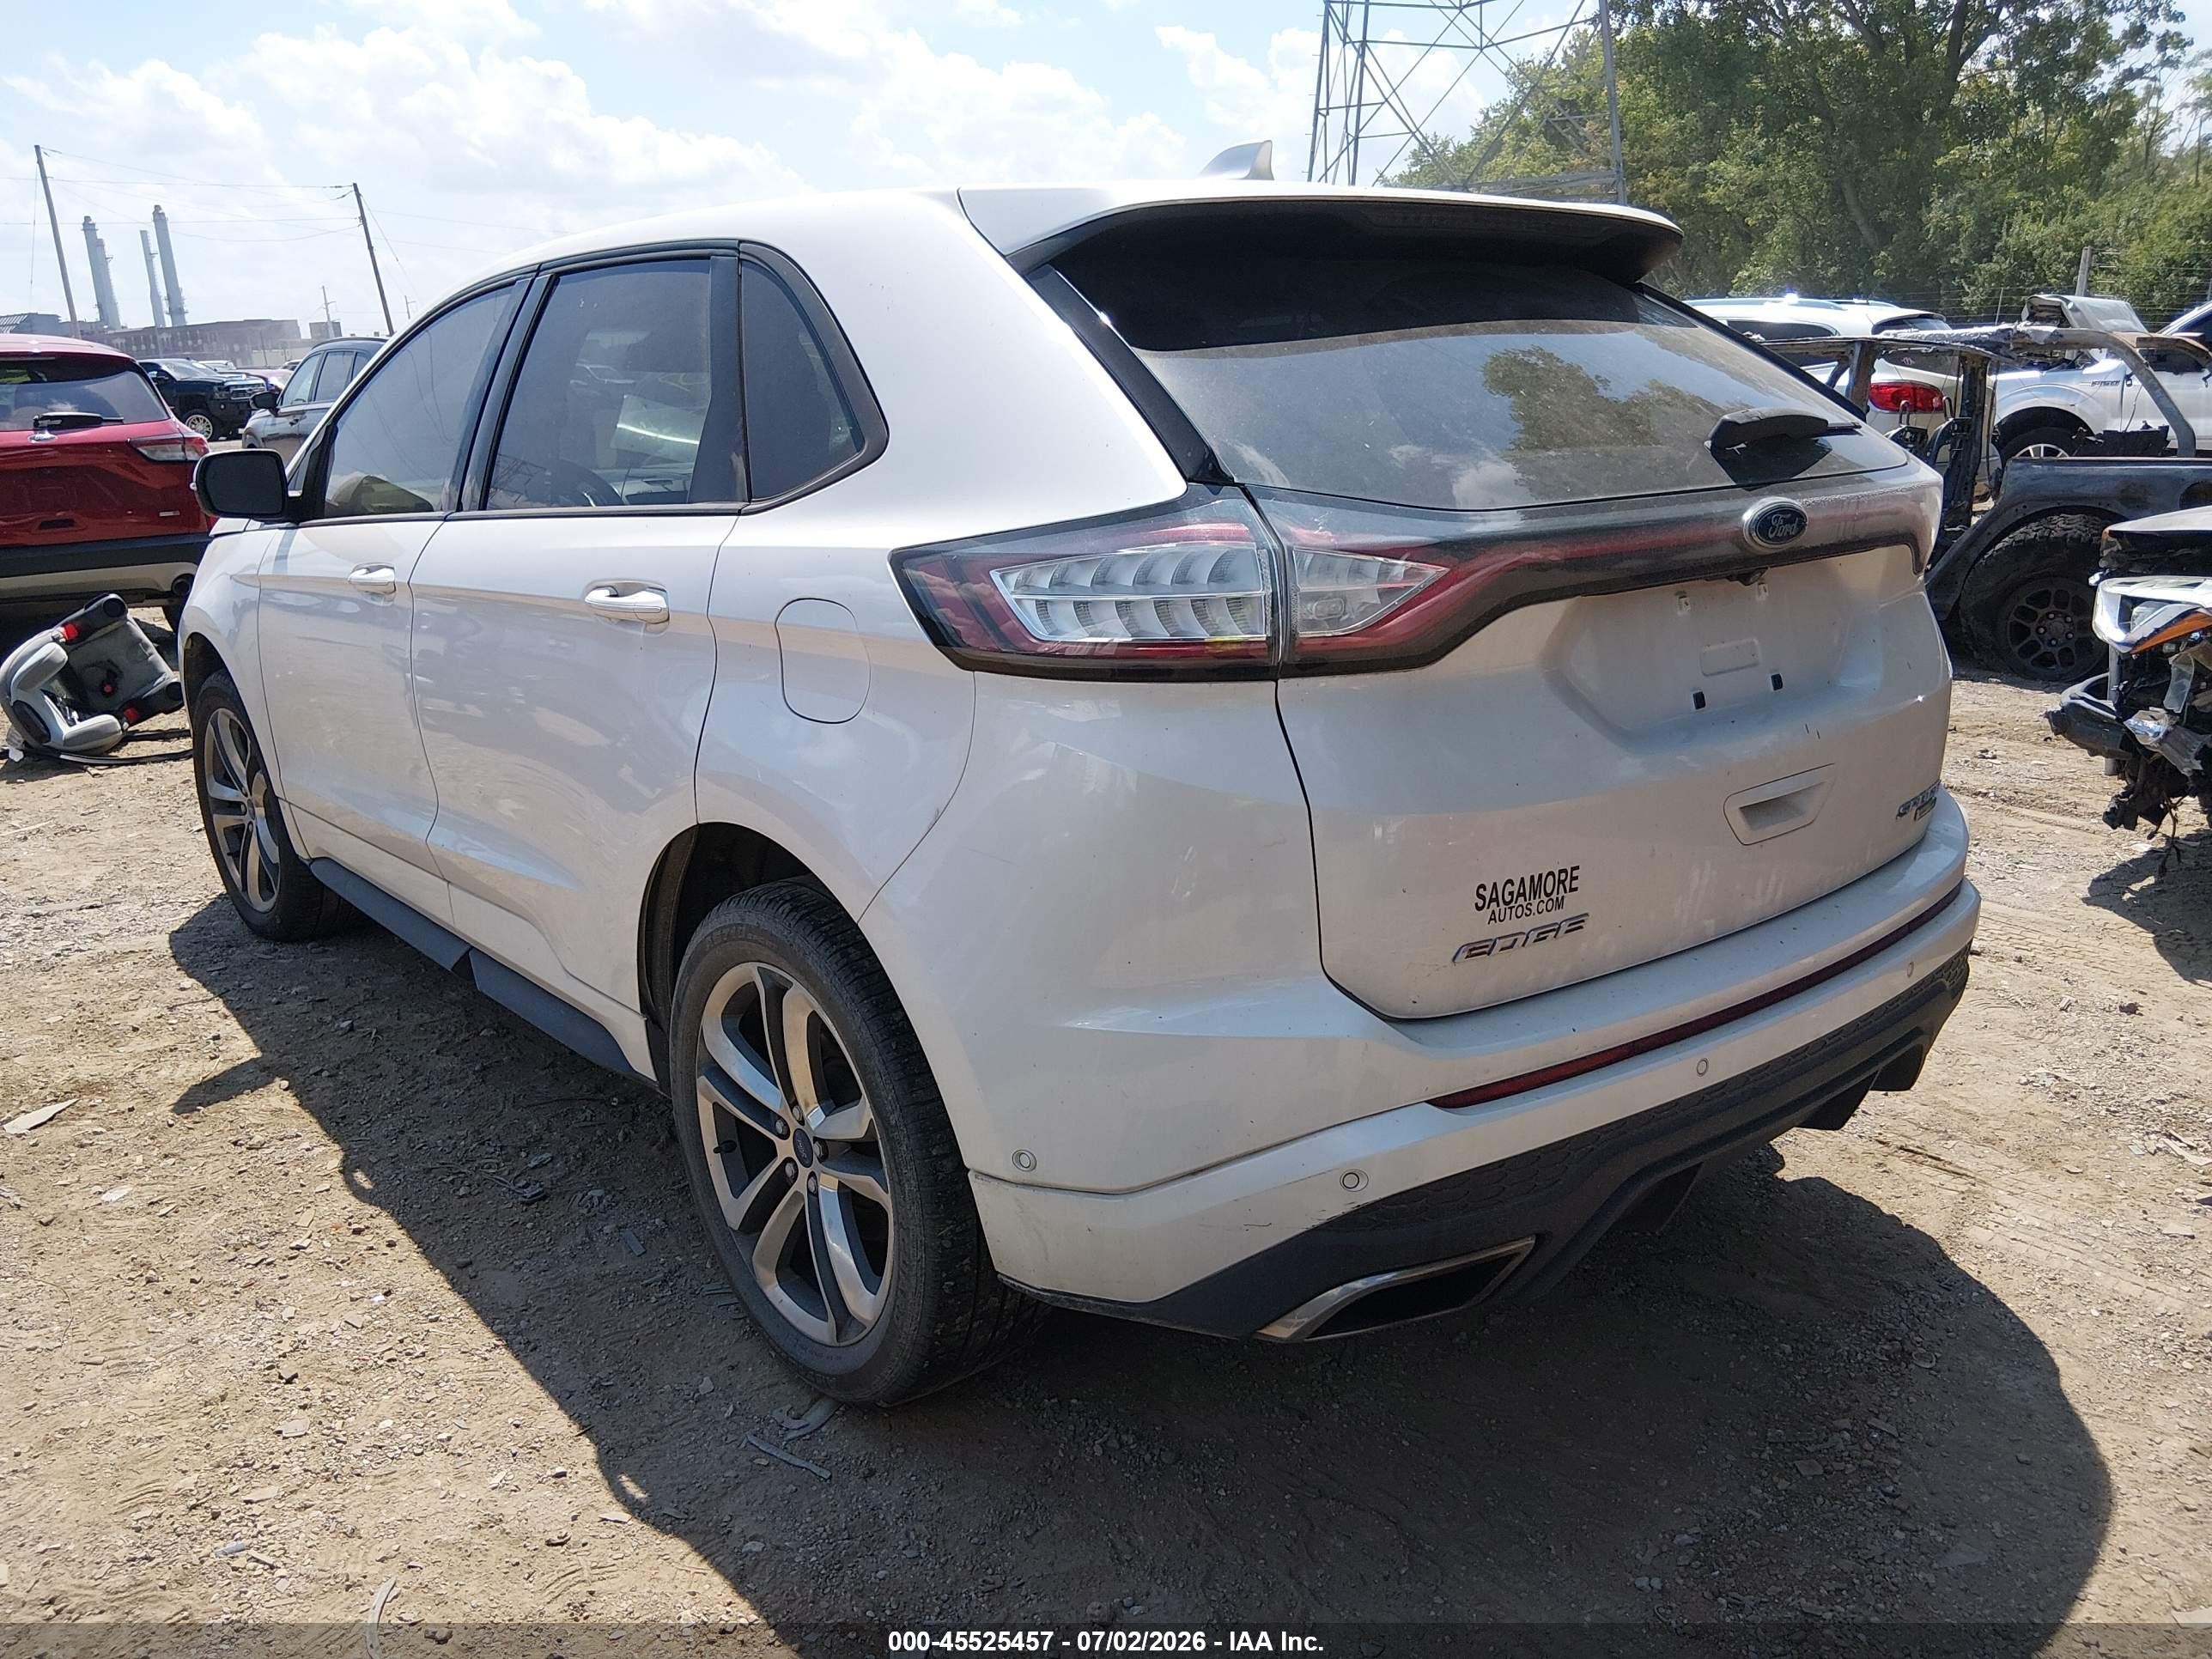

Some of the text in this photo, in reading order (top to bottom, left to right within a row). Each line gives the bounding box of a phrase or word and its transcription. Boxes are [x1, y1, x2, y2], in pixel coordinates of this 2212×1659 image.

[1768, 514, 1799, 538] Ford
[1474, 865, 1580, 911] SAGAMORE
[1487, 896, 1565, 925] AUTOS.COM
[1451, 913, 1589, 963] EDGE
